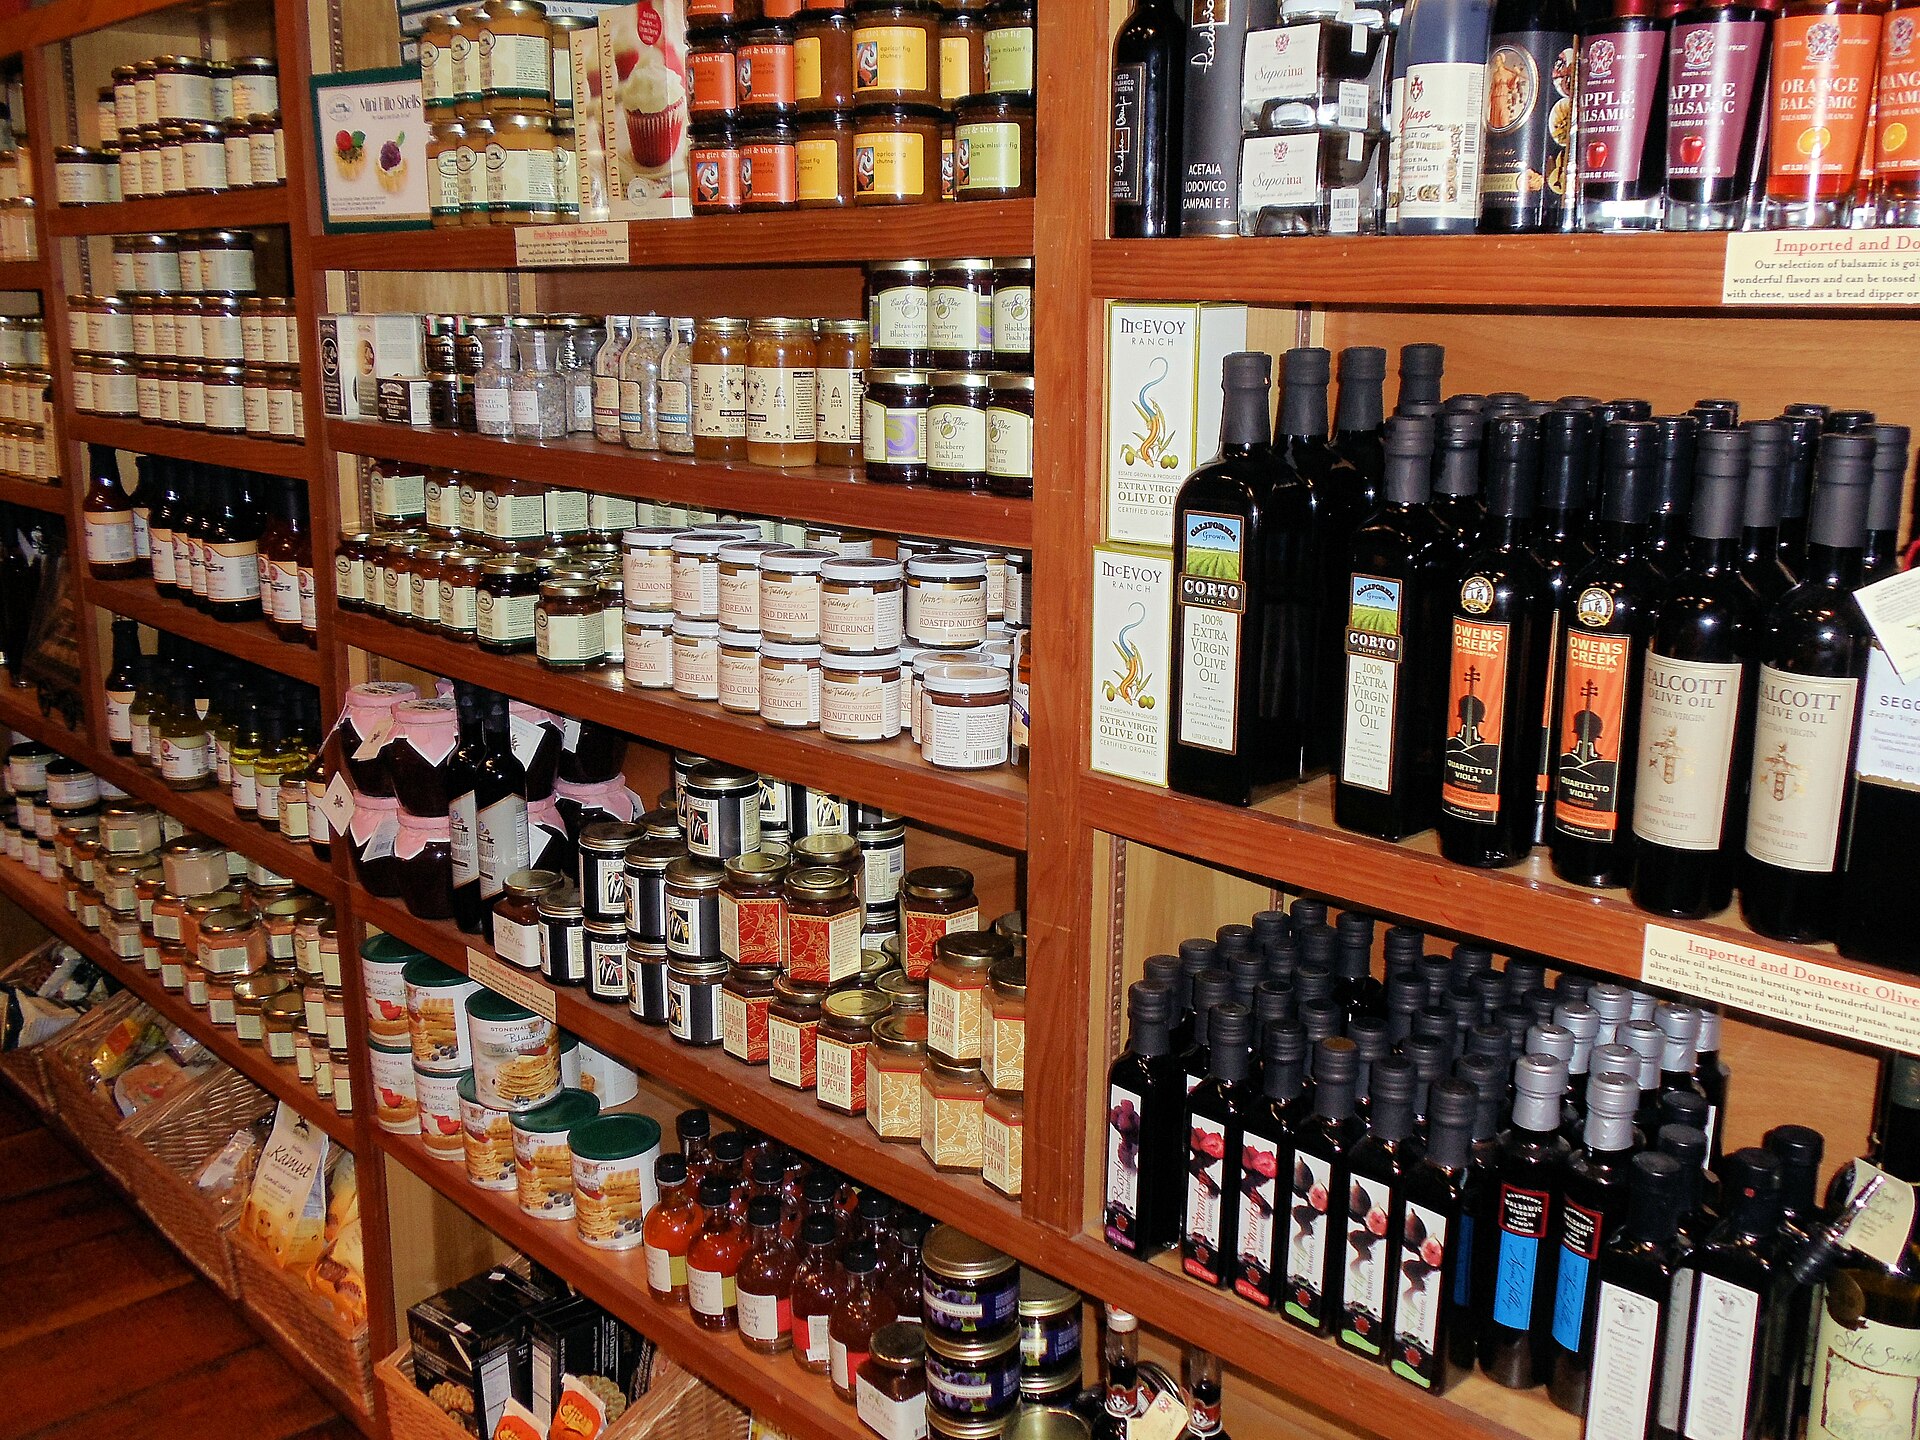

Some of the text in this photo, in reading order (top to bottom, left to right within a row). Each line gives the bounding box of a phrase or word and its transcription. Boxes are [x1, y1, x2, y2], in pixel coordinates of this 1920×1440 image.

[714, 55, 725, 63] fig
[775, 47, 786, 56] fig
[1255, 65, 1303, 83] Saporina
[1781, 78, 1859, 94] ORANGE
[706, 151, 719, 159] girl
[1189, 164, 1222, 175] ACETAIA
[1252, 172, 1303, 191] Saporina
[1216, 198, 1221, 209] E
[1775, 236, 1890, 256] Imported and
[1754, 258, 1900, 269] Our selection of balsamic is
[1732, 275, 1783, 284] wonderful
[1786, 275, 1820, 284] flavors
[1823, 274, 1843, 283] and
[1867, 274, 1879, 283] be
[1882, 274, 1916, 283] tossed
[1726, 290, 1747, 298] with
[1788, 289, 1811, 298] used
[1836, 289, 1865, 298] bread
[1868, 289, 1906, 300] dipper
[1131, 337, 1174, 346] RANCH
[934, 442, 966, 451] Blackberry
[951, 451, 964, 459] Jam
[1117, 481, 1147, 492] EXTRA
[1118, 491, 1156, 504] OLIVE
[1117, 506, 1149, 516] CERTIFIED
[1190, 521, 1237, 542] CALIFORNIA
[1202, 530, 1226, 541] Grown
[636, 582, 671, 590] ALMOND
[1112, 580, 1151, 593] RANCH
[1184, 579, 1239, 600] CORTO
[1356, 583, 1396, 602] CALIFORNIA
[1194, 596, 1216, 605] OLIVE
[726, 604, 752, 613] DREAM
[776, 612, 808, 620] DREAM
[919, 617, 971, 628] ROASTED NUT
[1201, 614, 1222, 625] 100%
[826, 624, 874, 633] NUT CRUNCH
[1193, 623, 1228, 641] EXTRA
[1455, 624, 1503, 641] OWENS
[1191, 637, 1230, 656] VIRGIN
[1349, 632, 1396, 651] CORTO
[1455, 636, 1499, 652] CREEK
[1570, 636, 1622, 654] OWENS
[1358, 647, 1375, 655] OLIVE
[1571, 650, 1618, 666] CREEK
[631, 661, 656, 669] DREAM
[1193, 652, 1226, 670] OLIVE
[1363, 662, 1383, 675] 100%
[1199, 668, 1219, 684] OIL
[1354, 672, 1388, 690] EXTRA
[1352, 685, 1389, 704] VIRGIN
[768, 698, 802, 708] CRUNCH
[1354, 699, 1386, 717] OLIVE
[1689, 697, 1716, 708] OIL
[832, 711, 882, 721] NUT CRUNCH
[1359, 714, 1379, 730] OIL
[1800, 712, 1827, 724] OIL
[1099, 716, 1158, 734] EXTRA VIRGIN
[1099, 725, 1158, 745] OLIVE OIL
[1099, 739, 1158, 757] CERTIFIED ORGANIC
[1447, 760, 1493, 776] QUARTETTO
[1561, 777, 1610, 792] QUARTETTO
[1688, 939, 1920, 1007] Imported and Domestic Olive
[1649, 948, 1907, 1019] Our olive oil selection is bursting with wonderful local
[1650, 961, 1891, 1030] olive oils. Try them tossed with your favorite pastas,
[1666, 976, 1680, 988] dip
[1682, 982, 1701, 993] with
[1703, 988, 1726, 999] fresh
[1729, 993, 1754, 1007] bread
[1756, 1002, 1767, 1010] or
[1769, 1005, 1794, 1017] make
[1805, 1013, 1860, 1034] homemade
[1863, 1029, 1914, 1048] marinade
[931, 1021, 954, 1044] CARAMEL
[270, 1145, 312, 1178] Kamut
[1505, 1200, 1542, 1212] BALSAMIC
[1564, 1213, 1594, 1232] BALSAMIC
